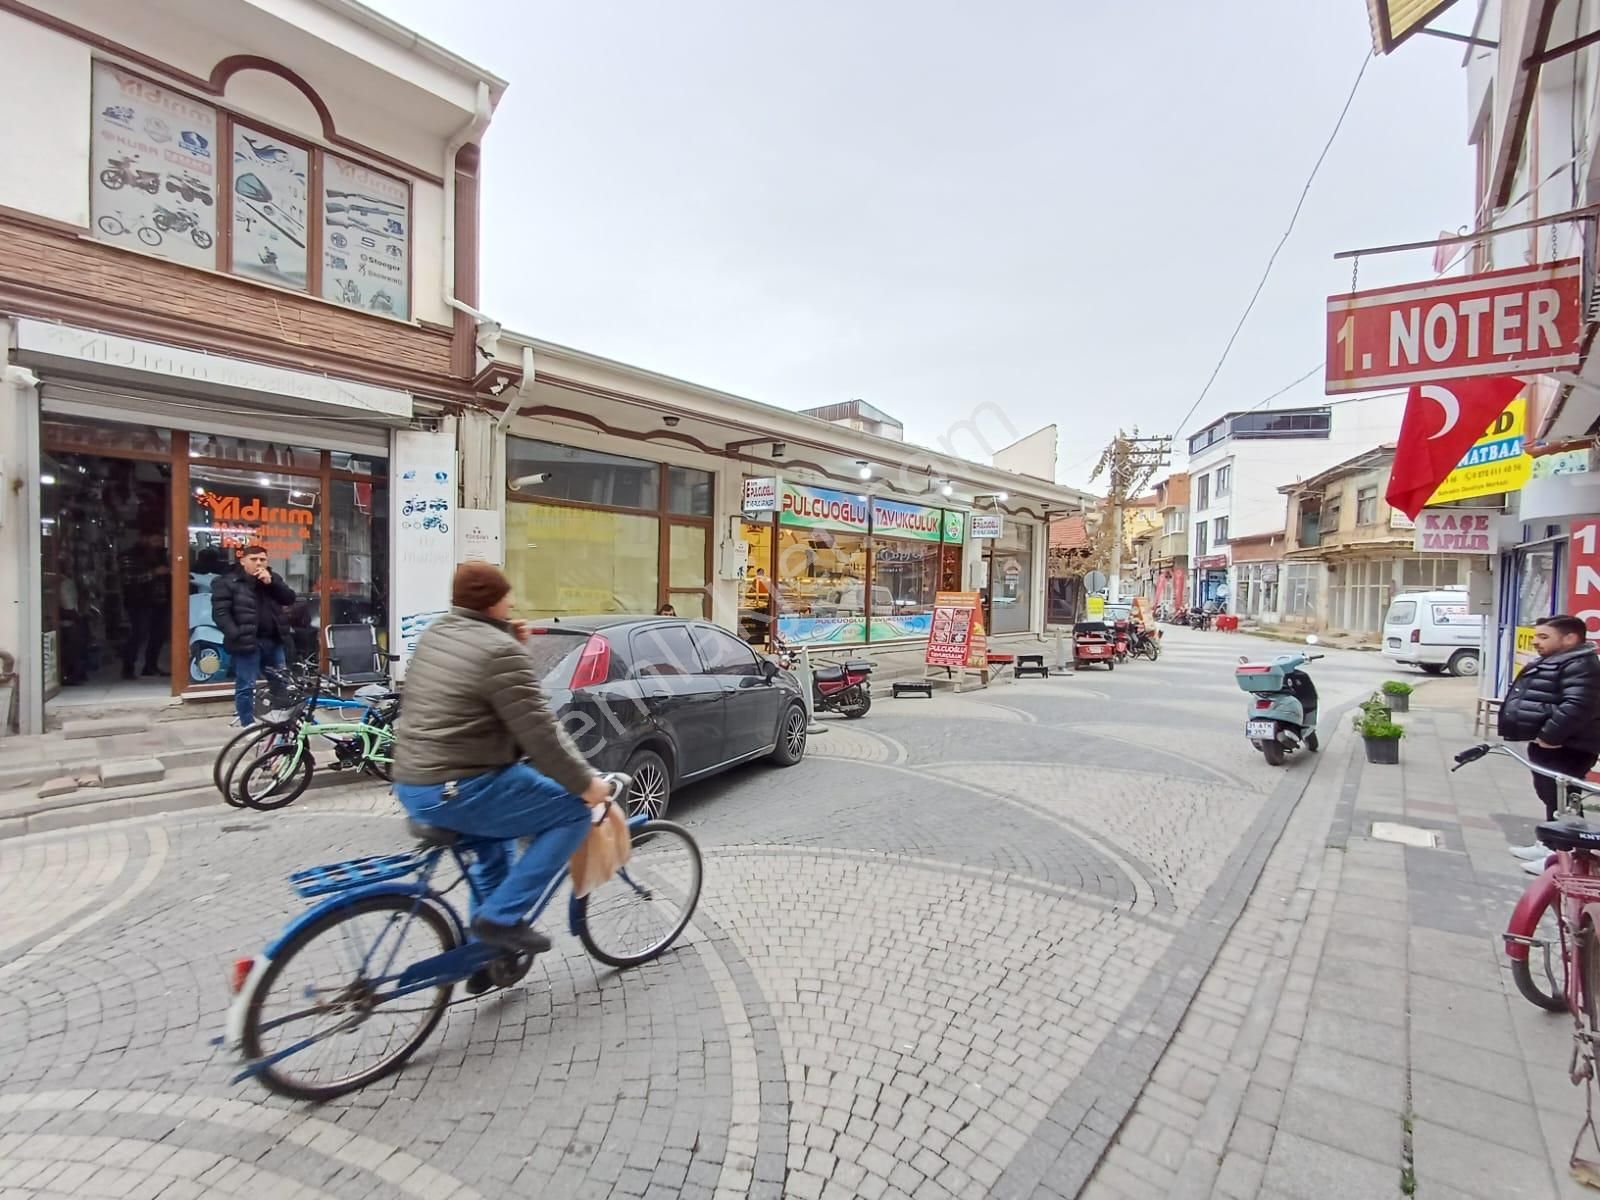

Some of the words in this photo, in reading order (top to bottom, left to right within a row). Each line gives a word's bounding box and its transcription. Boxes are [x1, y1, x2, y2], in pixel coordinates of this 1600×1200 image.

[1336, 315, 1372, 372] 1.
[1388, 287, 1563, 368] NOTER
[782, 493, 866, 524] PULCUOĞLU
[1424, 514, 1489, 533] KAŞE
[1423, 533, 1490, 550] YAPILIR
